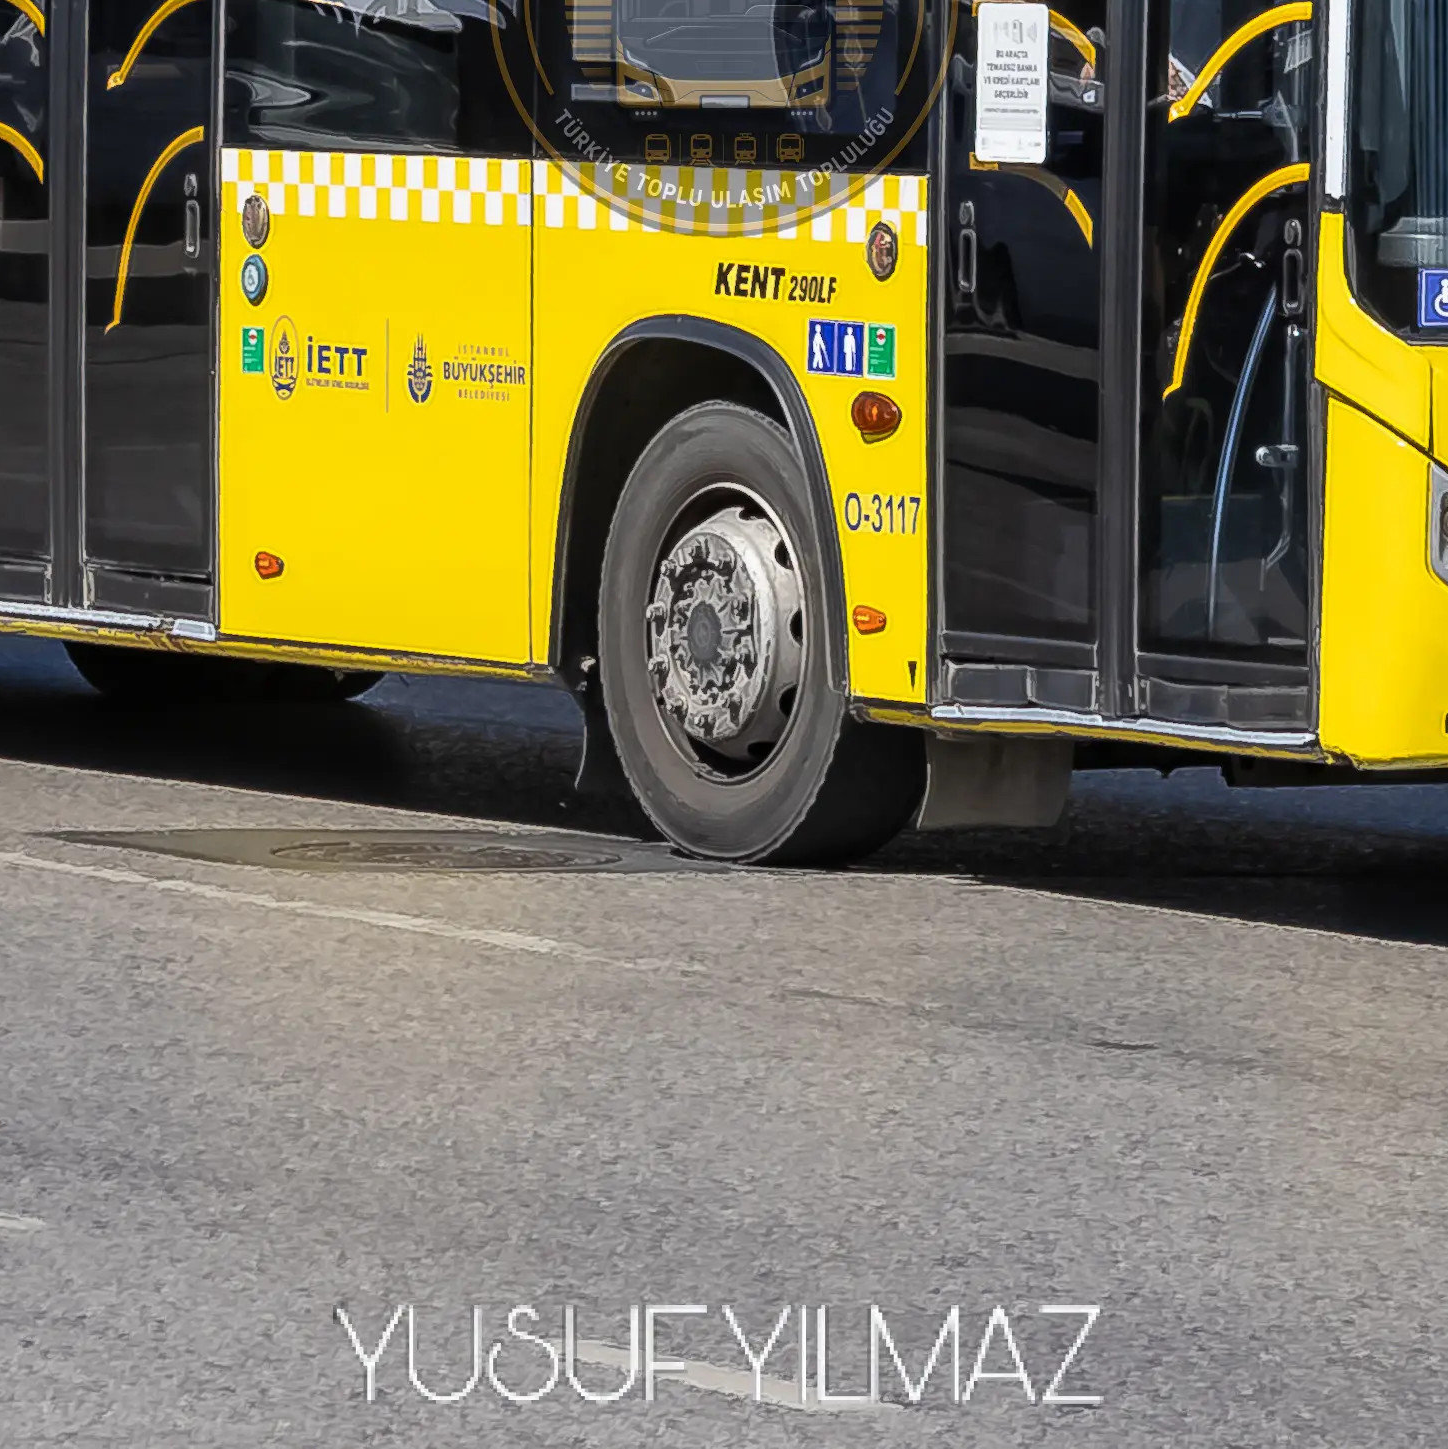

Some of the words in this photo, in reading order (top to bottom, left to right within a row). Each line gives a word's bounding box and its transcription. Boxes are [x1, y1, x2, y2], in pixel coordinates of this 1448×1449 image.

[714, 262, 786, 300] KENT
[788, 276, 838, 304] 290LF
[307, 336, 368, 377] İETT
[458, 344, 510, 358] İSTANBUL
[443, 356, 526, 389] BÜYÜKŞEHİR
[844, 492, 921, 534] O-3117
